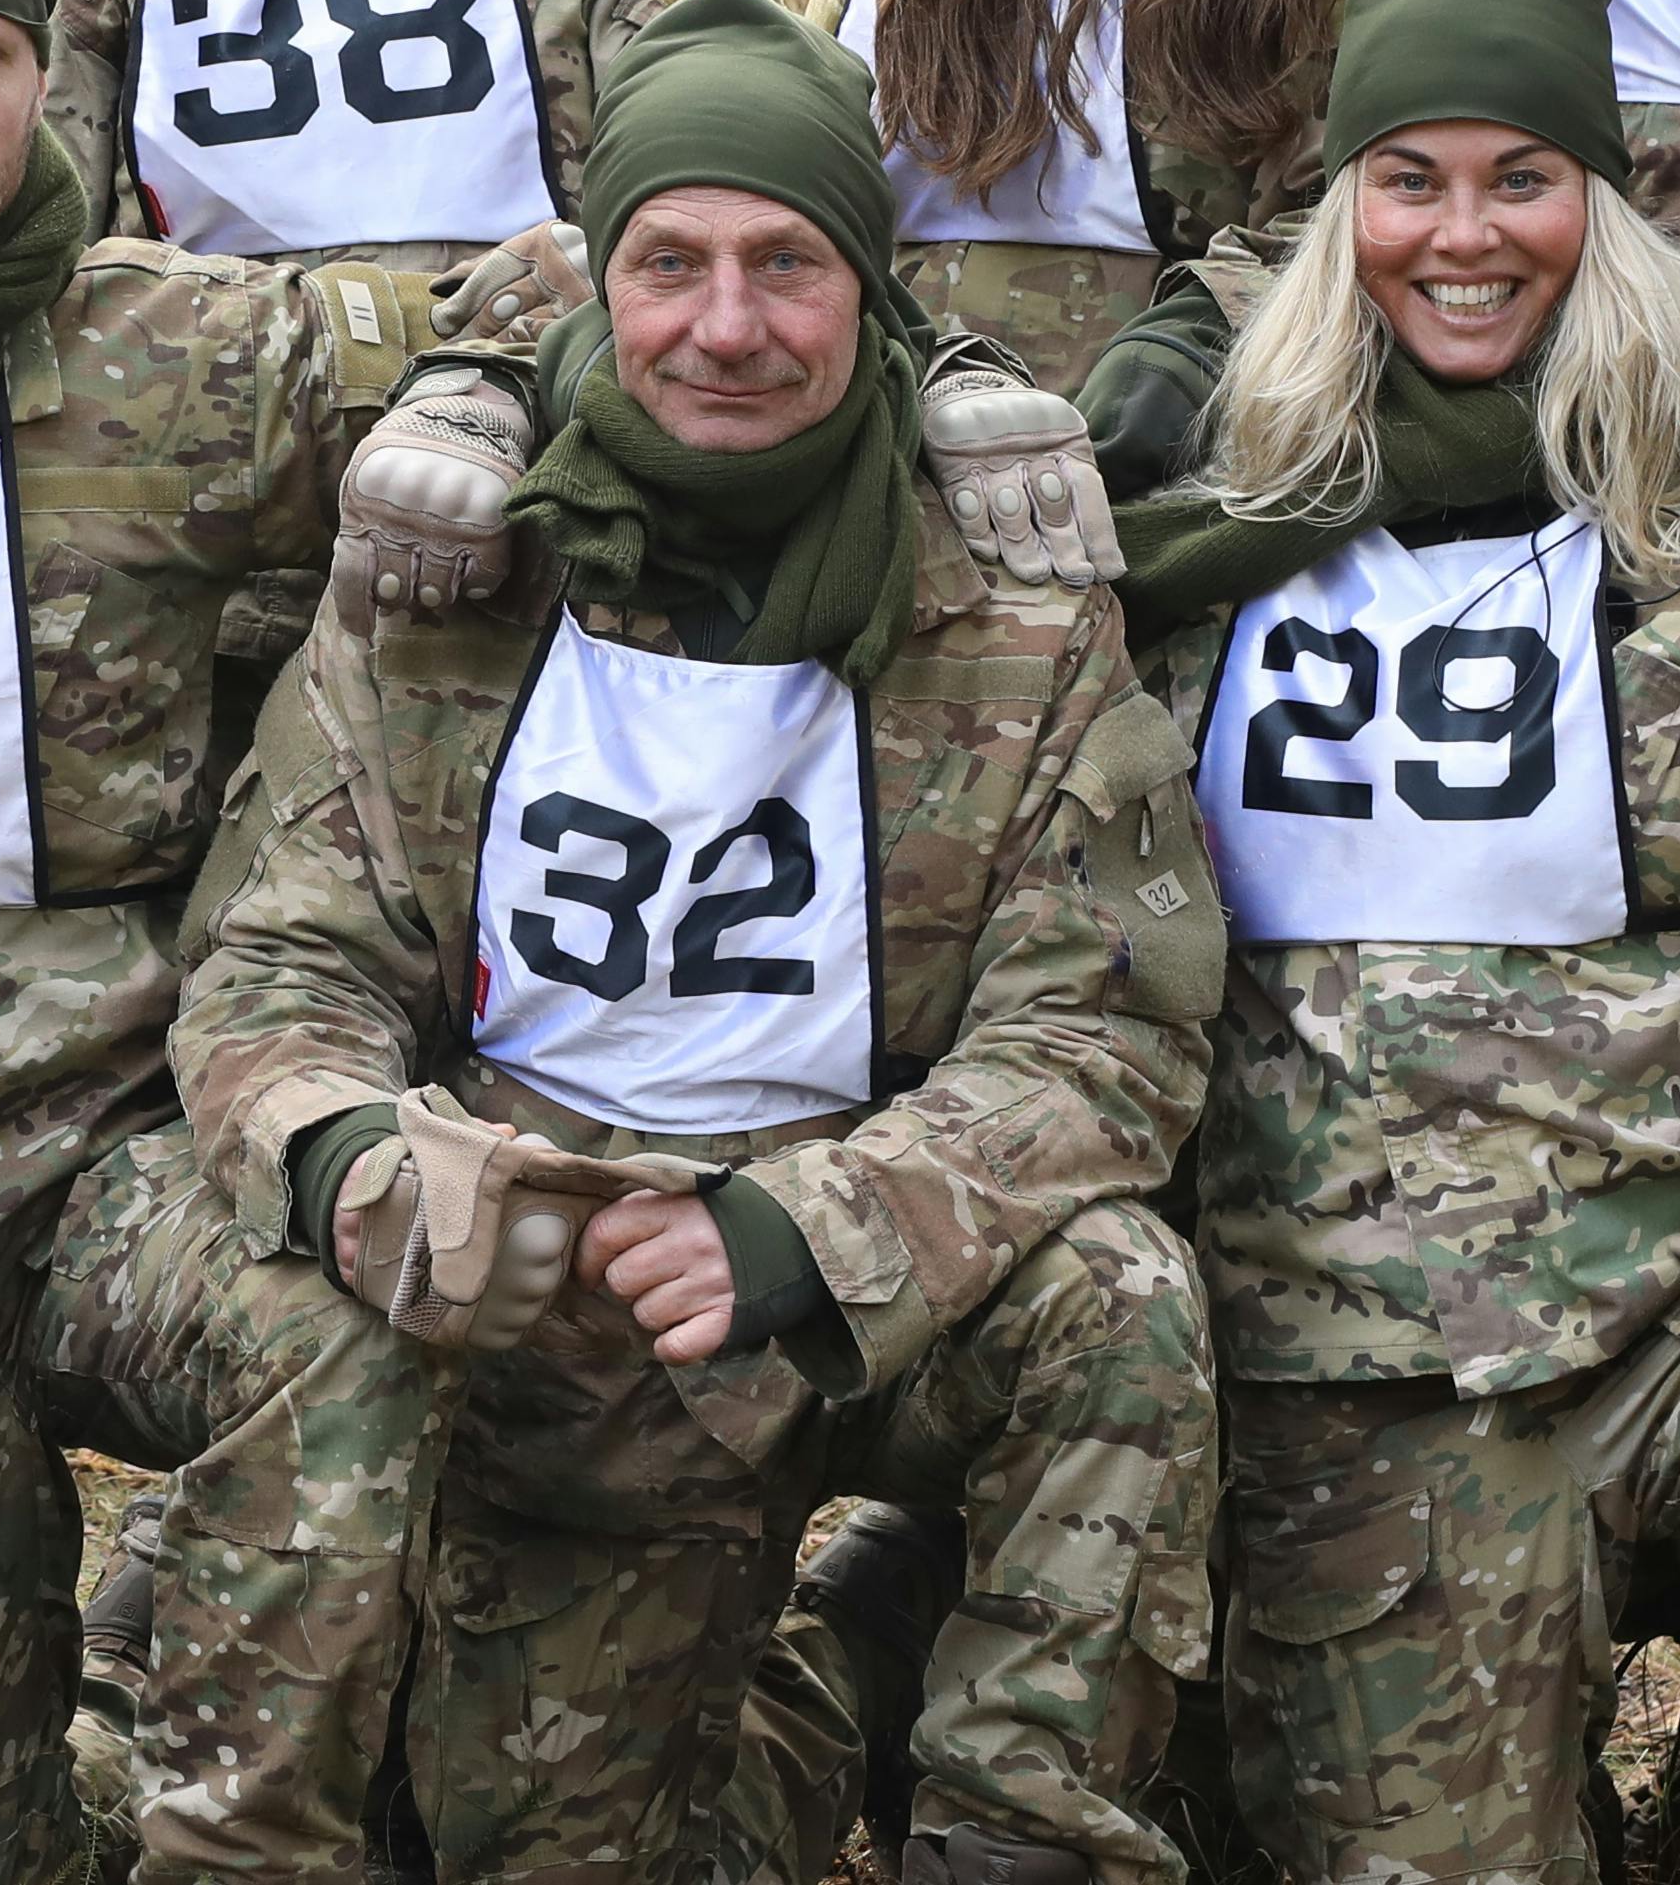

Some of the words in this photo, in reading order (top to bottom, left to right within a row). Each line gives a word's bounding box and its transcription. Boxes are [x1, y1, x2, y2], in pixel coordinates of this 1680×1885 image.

[1242, 616, 1561, 821] 29
[509, 791, 816, 1003] 32
[1148, 882, 1179, 911] 32
